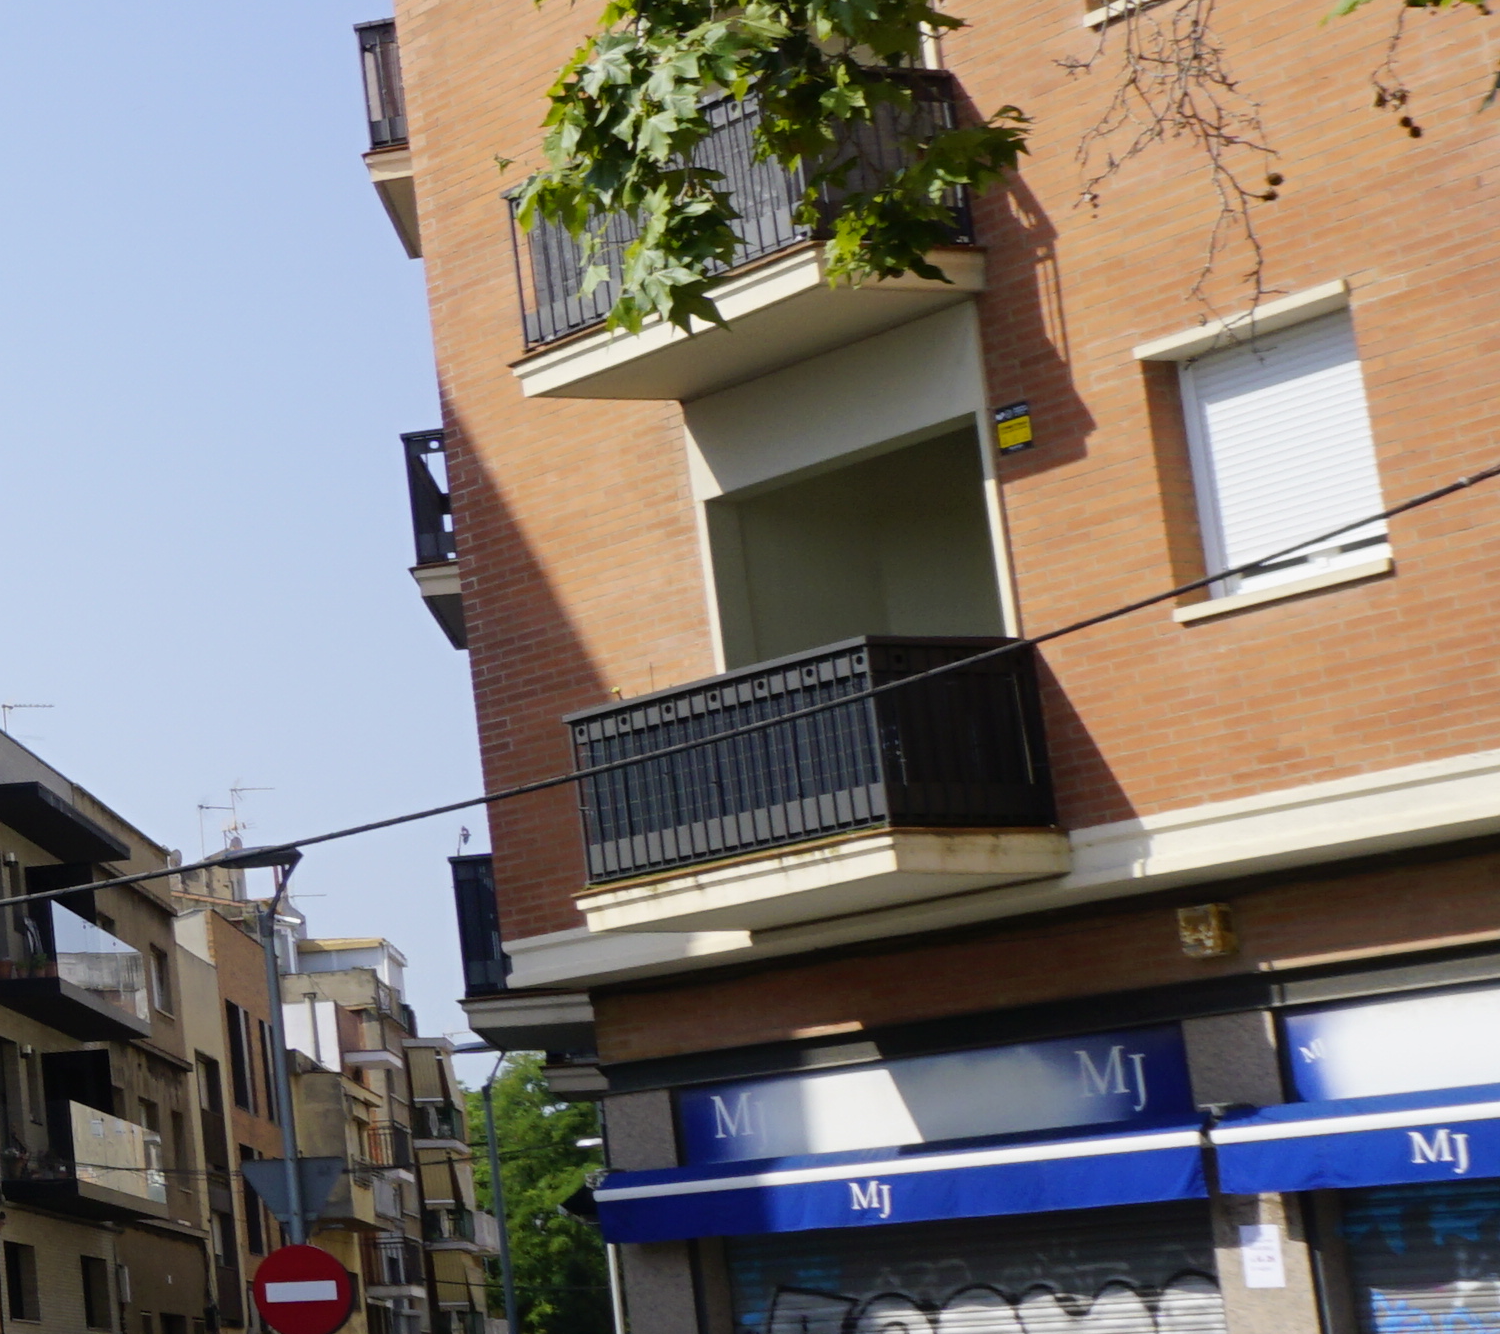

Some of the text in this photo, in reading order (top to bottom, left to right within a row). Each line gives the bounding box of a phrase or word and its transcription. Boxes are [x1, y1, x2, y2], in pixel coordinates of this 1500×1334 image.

[1074, 1045, 1148, 1112] MJ
[1406, 1128, 1470, 1175] MJ
[848, 1179, 893, 1220] MJ
